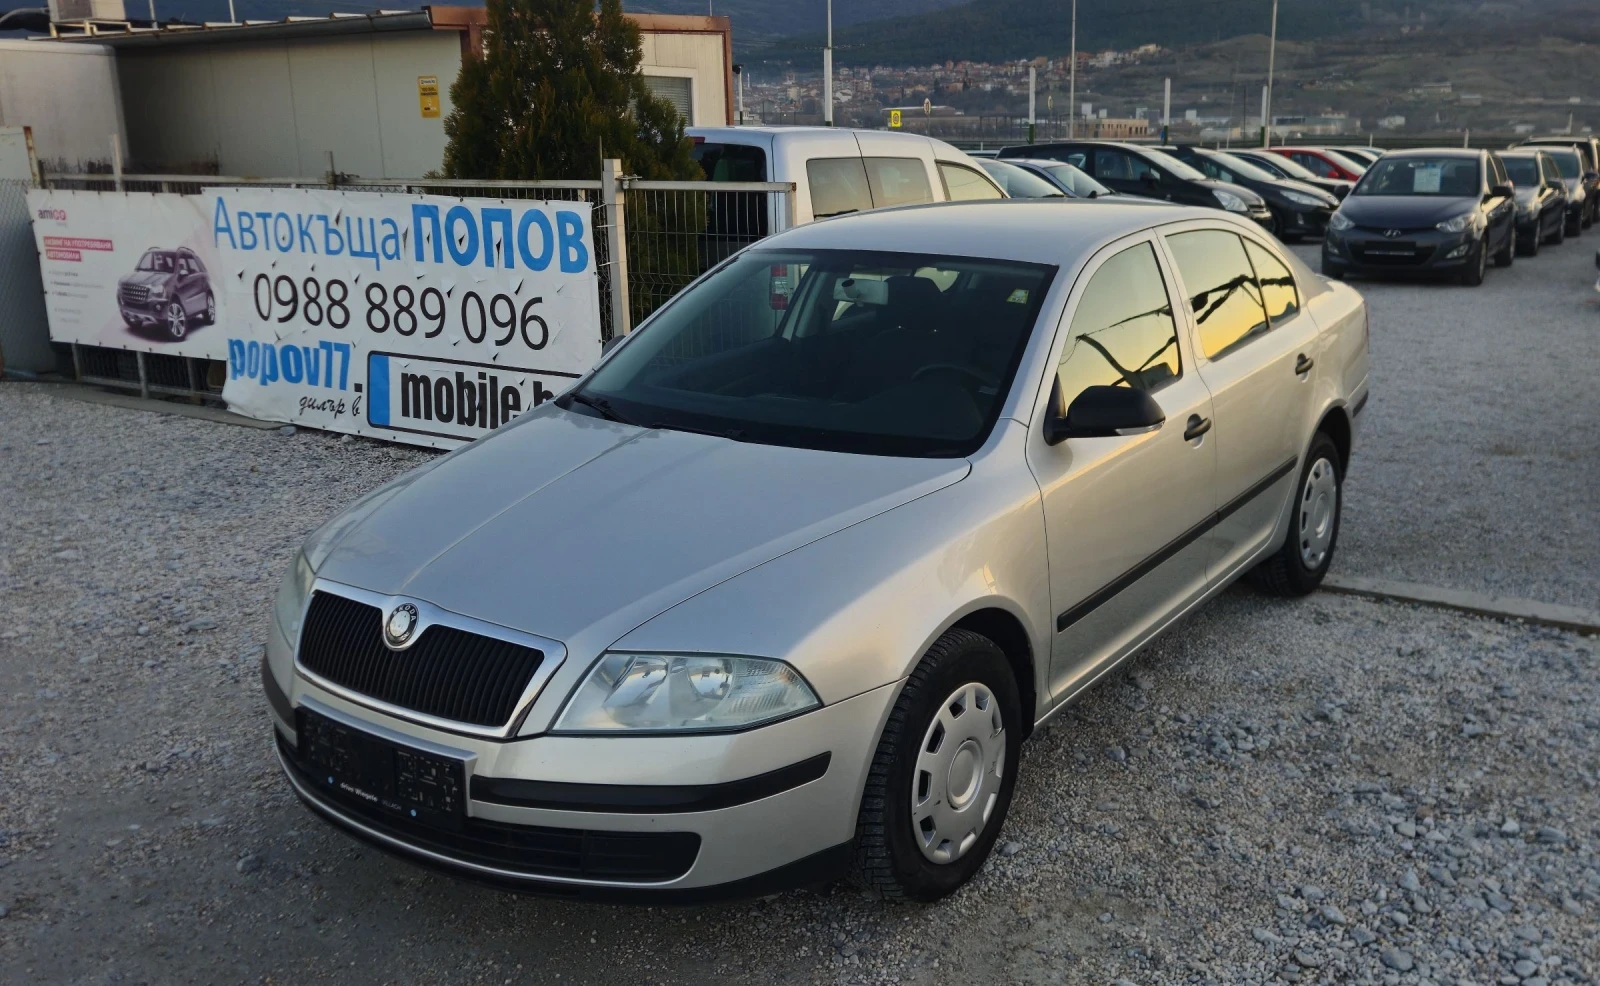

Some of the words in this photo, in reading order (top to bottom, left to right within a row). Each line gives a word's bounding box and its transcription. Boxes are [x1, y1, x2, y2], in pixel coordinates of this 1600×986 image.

[214, 196, 402, 271] Автокъща
[412, 204, 589, 274] ПОПОВ
[254, 273, 350, 329] 0988
[365, 282, 446, 338] 889
[461, 290, 549, 350] 096
